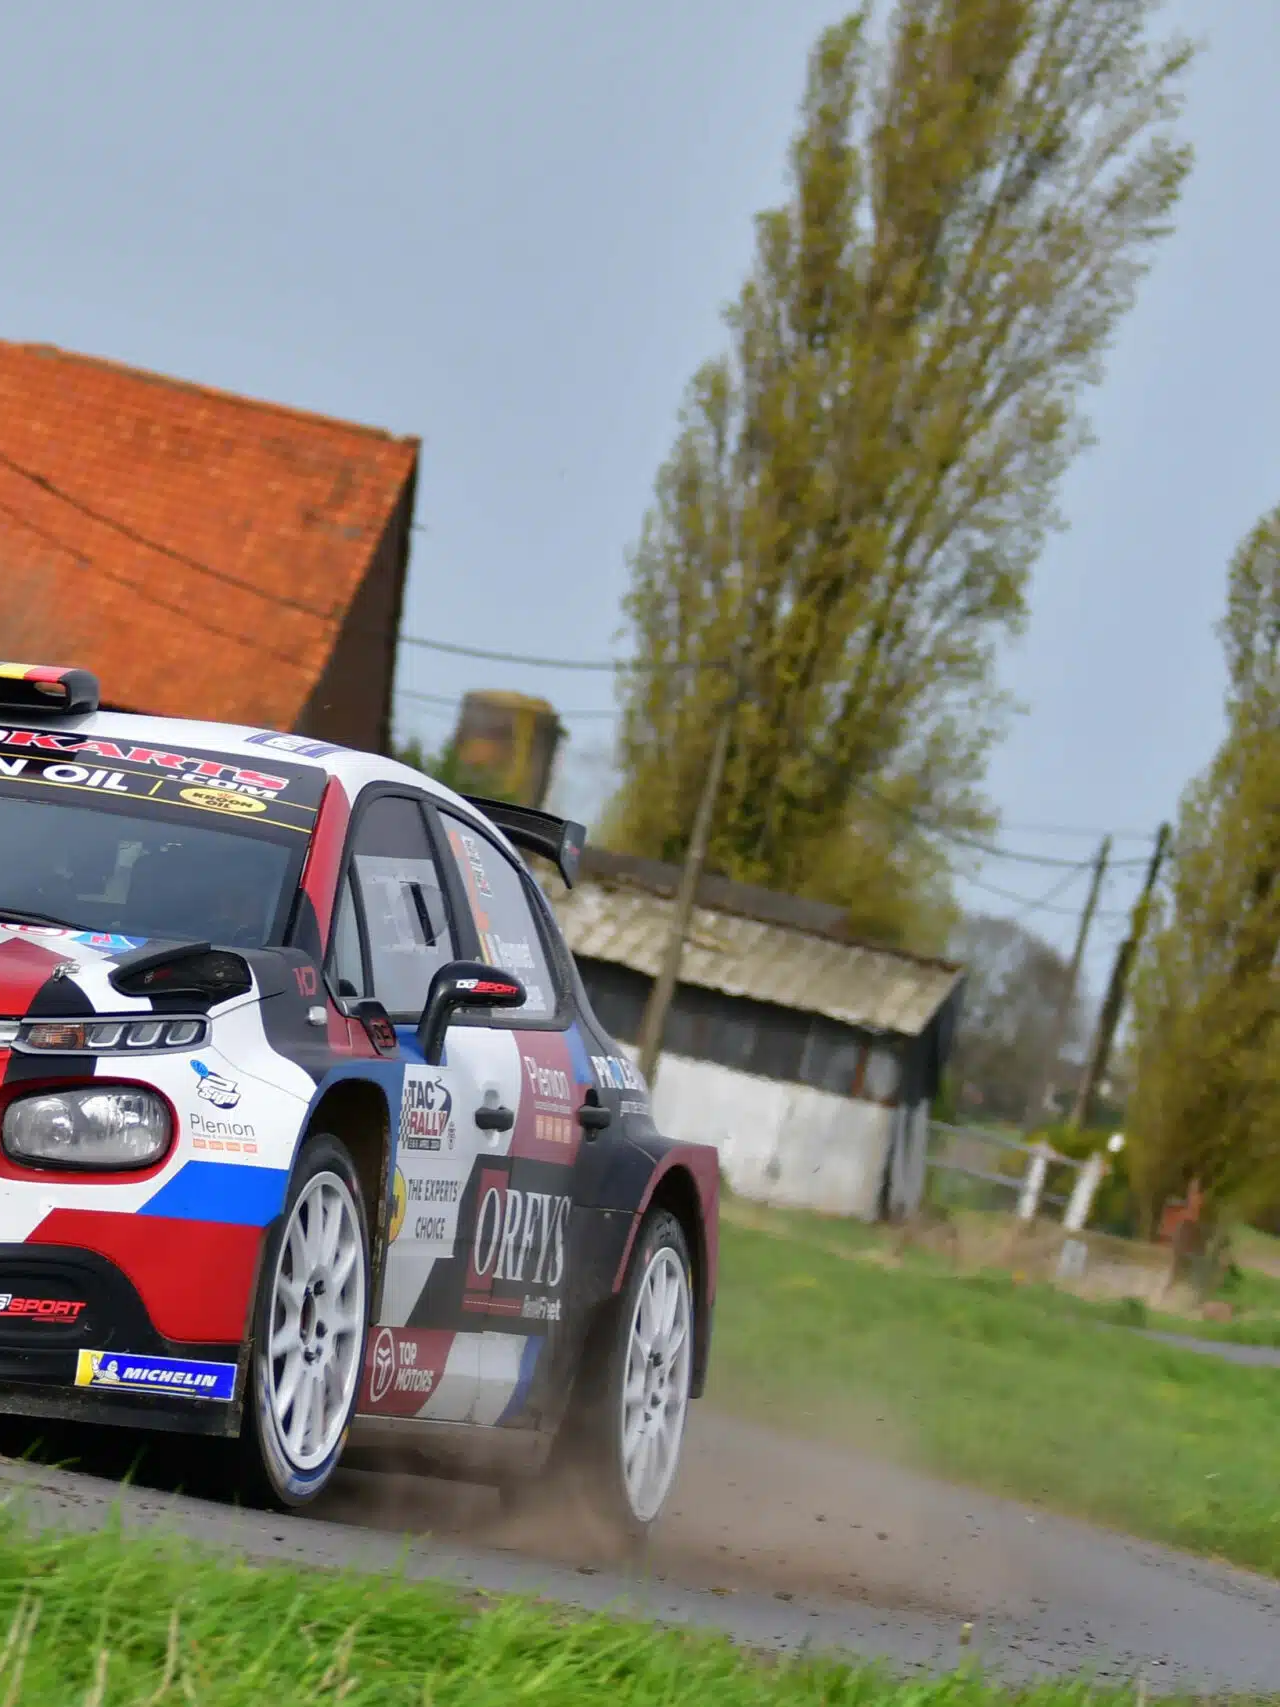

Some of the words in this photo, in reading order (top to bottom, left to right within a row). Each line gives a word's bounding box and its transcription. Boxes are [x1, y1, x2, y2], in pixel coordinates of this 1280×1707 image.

[43, 764, 129, 792] OIL
[165, 769, 279, 799] .COM
[192, 790, 253, 809] KROON
[204, 800, 233, 810] OIL
[408, 1080, 435, 1111] TAC
[190, 1112, 255, 1137] Plenion
[407, 1111, 447, 1137] RALLY
[408, 1179, 422, 1201] THE
[415, 1216, 446, 1240] CHOICE
[399, 1341, 418, 1366] TOP
[122, 1367, 218, 1388] MICHELIN
[394, 1367, 435, 1393] MOTORS
